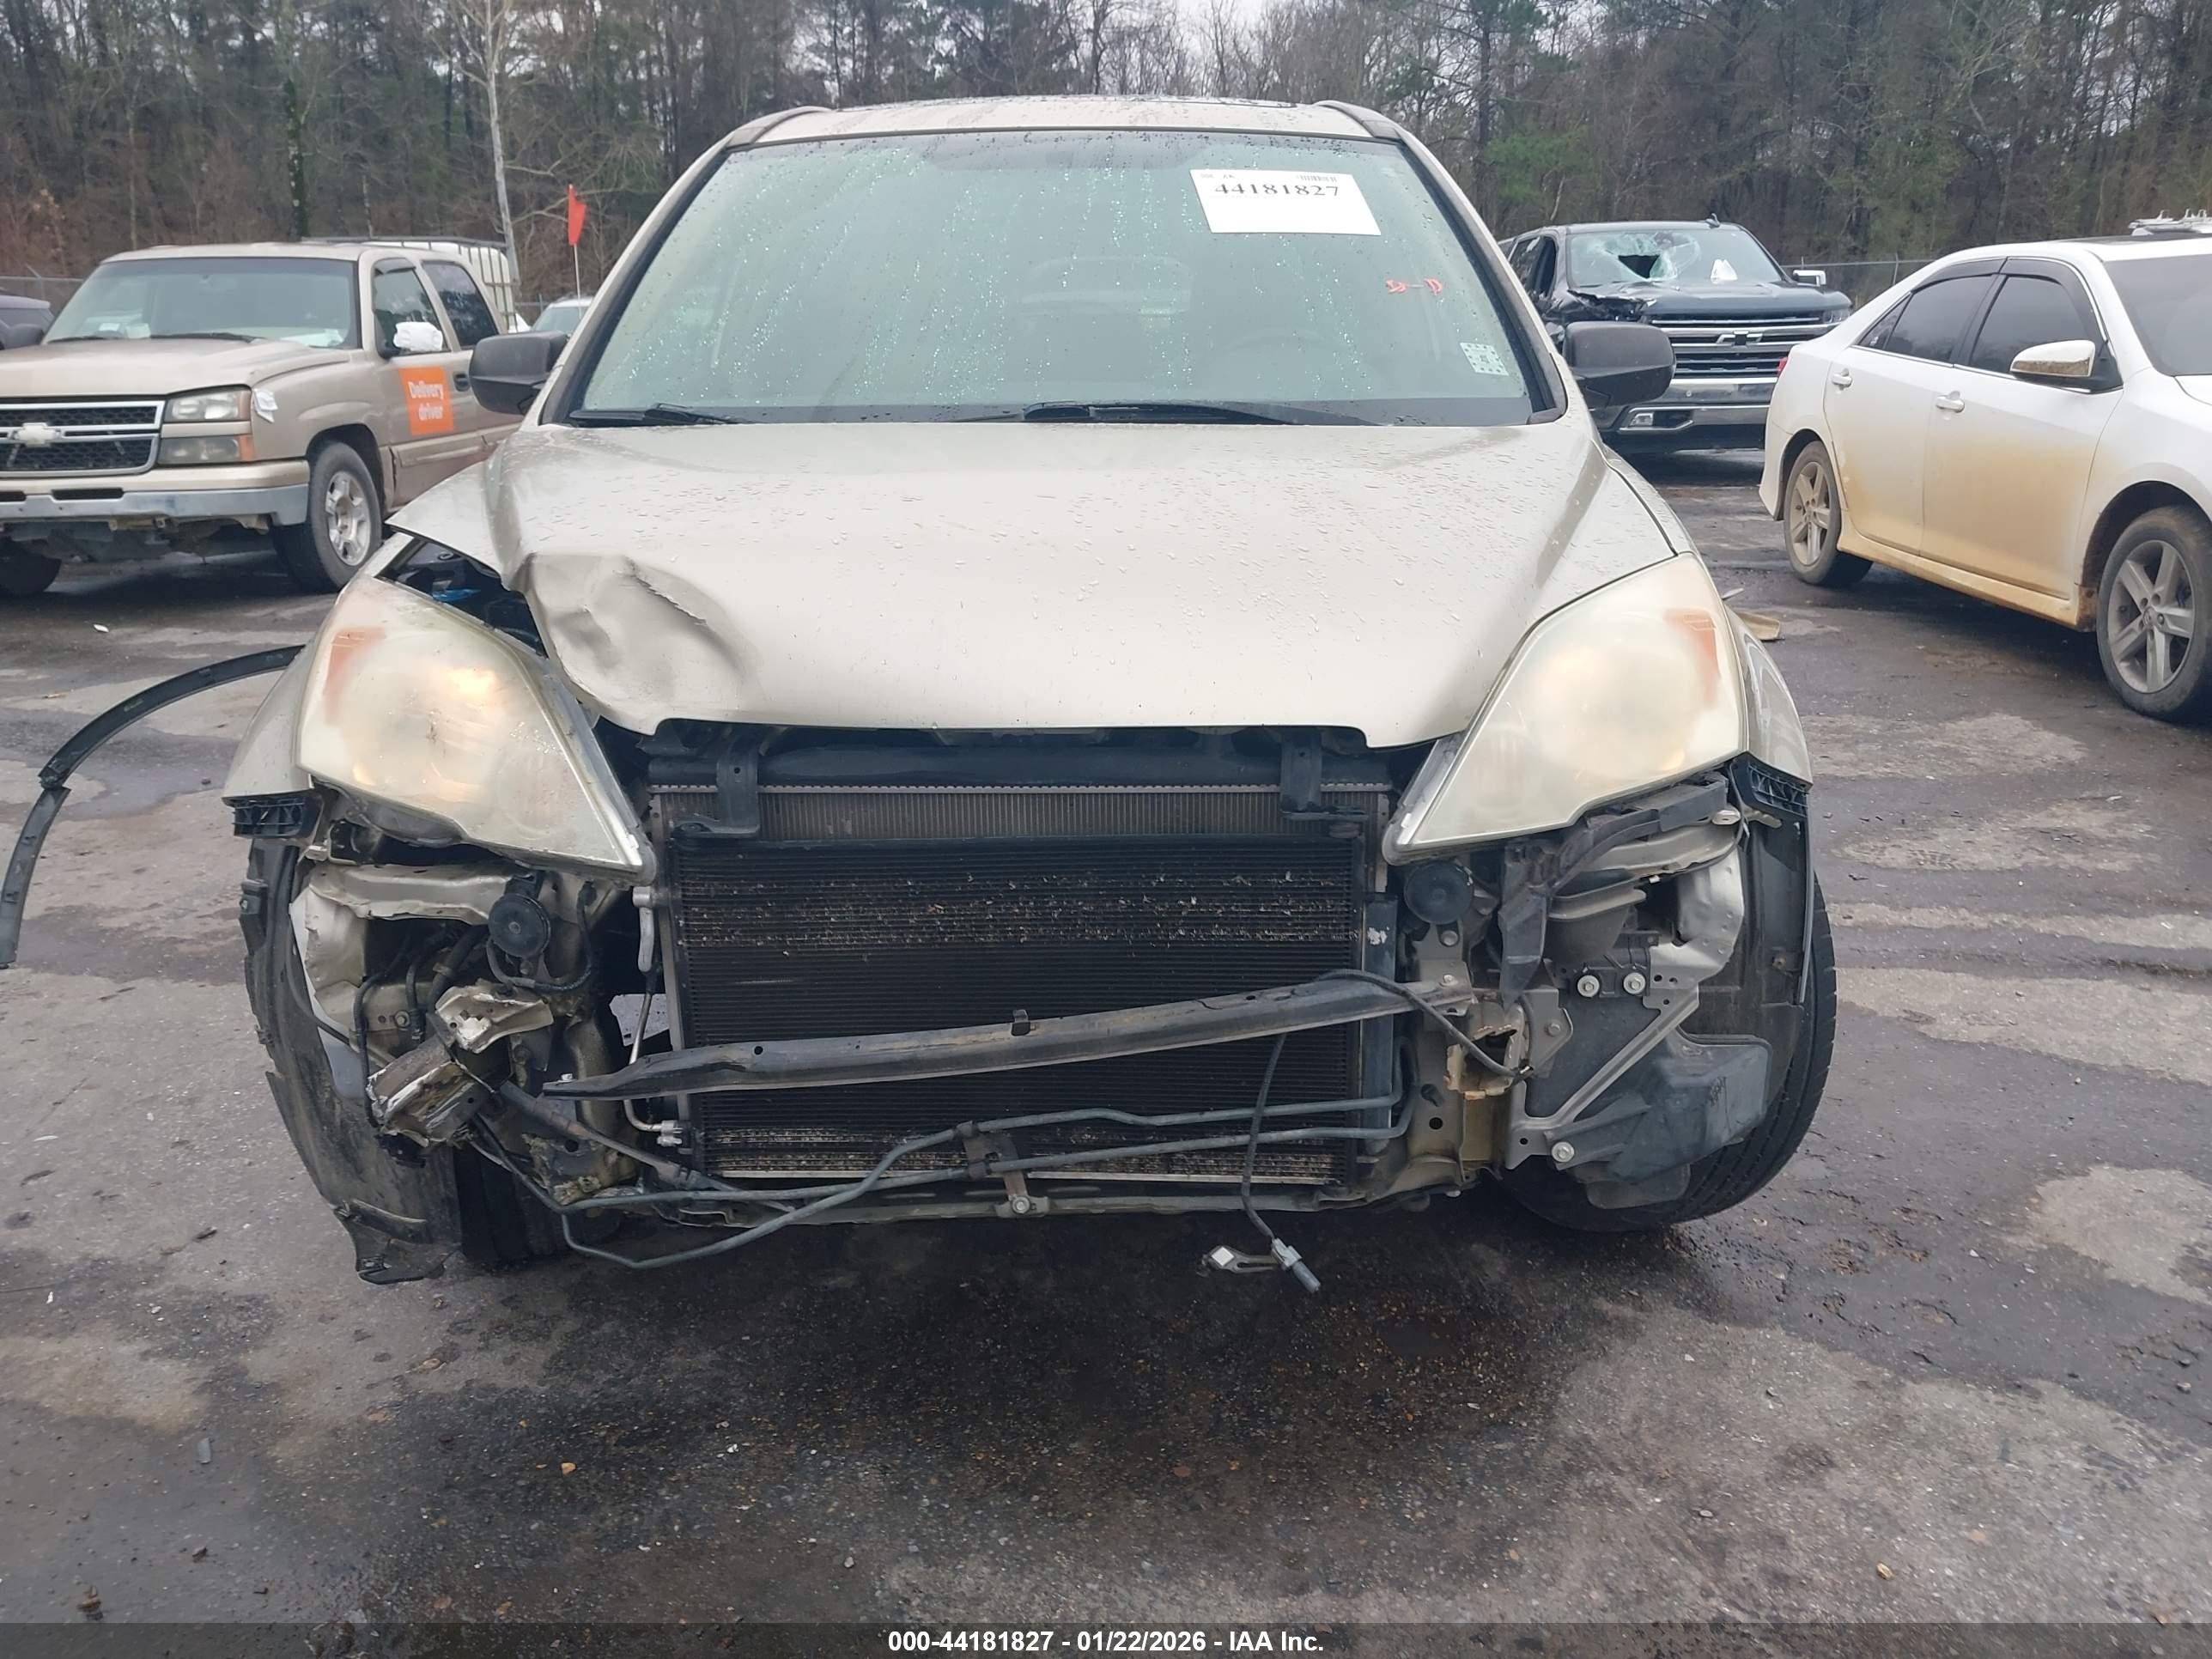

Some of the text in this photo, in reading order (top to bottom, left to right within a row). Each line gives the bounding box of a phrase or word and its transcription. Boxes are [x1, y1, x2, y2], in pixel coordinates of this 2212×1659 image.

[1215, 183, 1339, 197] 44181827
[407, 380, 444, 400] Delivery
[418, 402, 444, 422] driver
